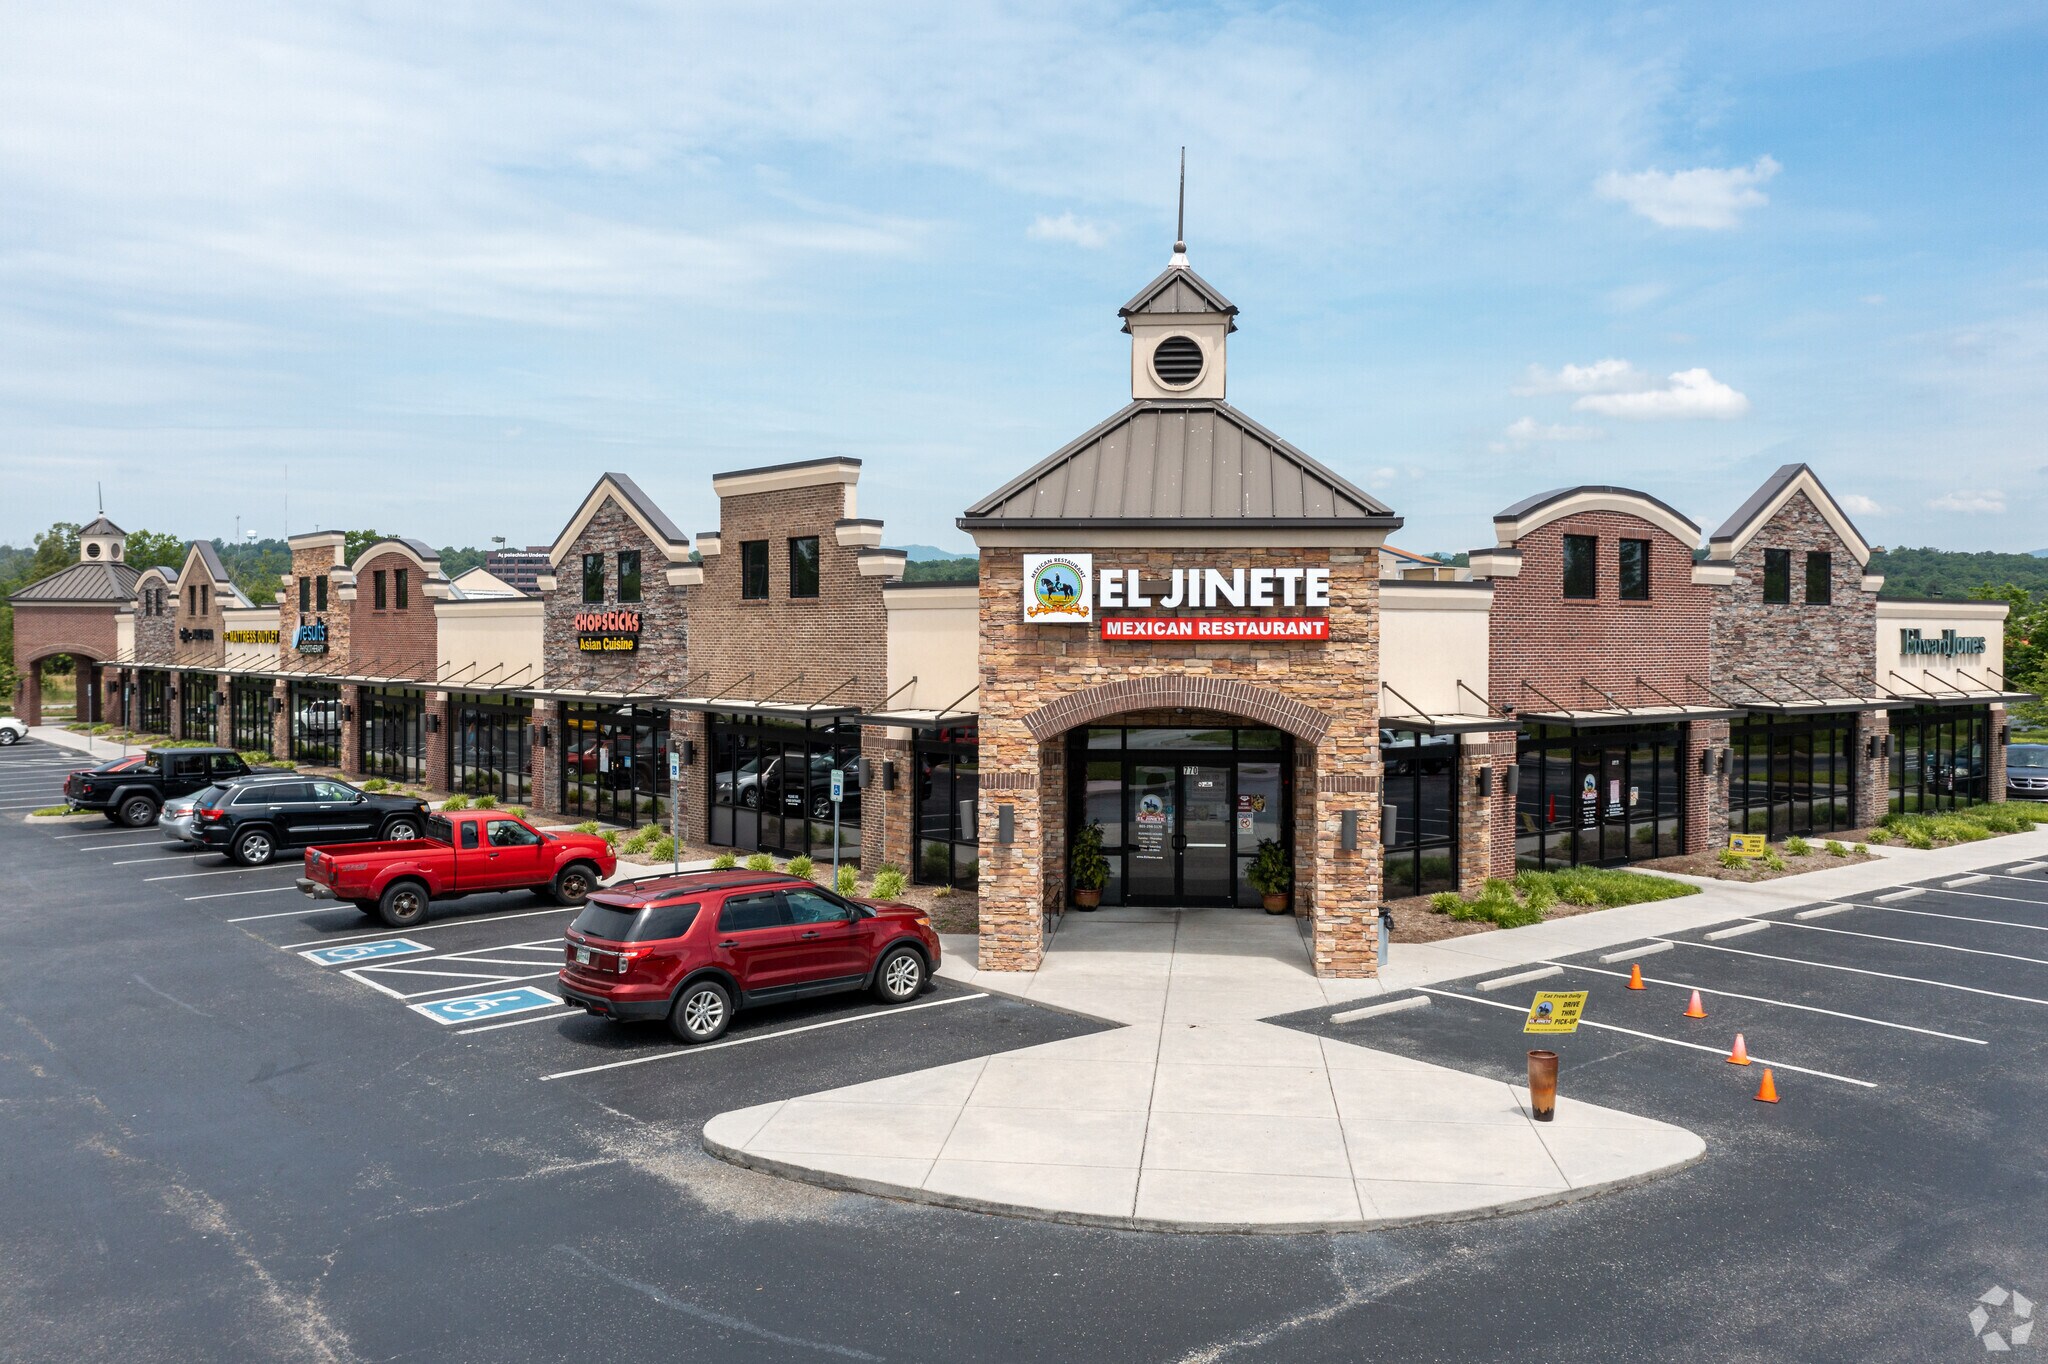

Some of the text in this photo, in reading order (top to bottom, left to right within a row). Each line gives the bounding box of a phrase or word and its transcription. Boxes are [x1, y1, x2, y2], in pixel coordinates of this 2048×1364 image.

[1031, 558, 1086, 579] MEXICAN RESTAURANT
[1100, 568, 1330, 608] EL JINETE
[1106, 621, 1325, 635] MEXICAN RESTAURANT
[230, 630, 256, 644] MATTRESS
[258, 630, 279, 644] OUTLET
[580, 637, 634, 651] Asian Cuisine
[1900, 628, 1986, 658] Edward Jones
[1184, 766, 1199, 775] 770
